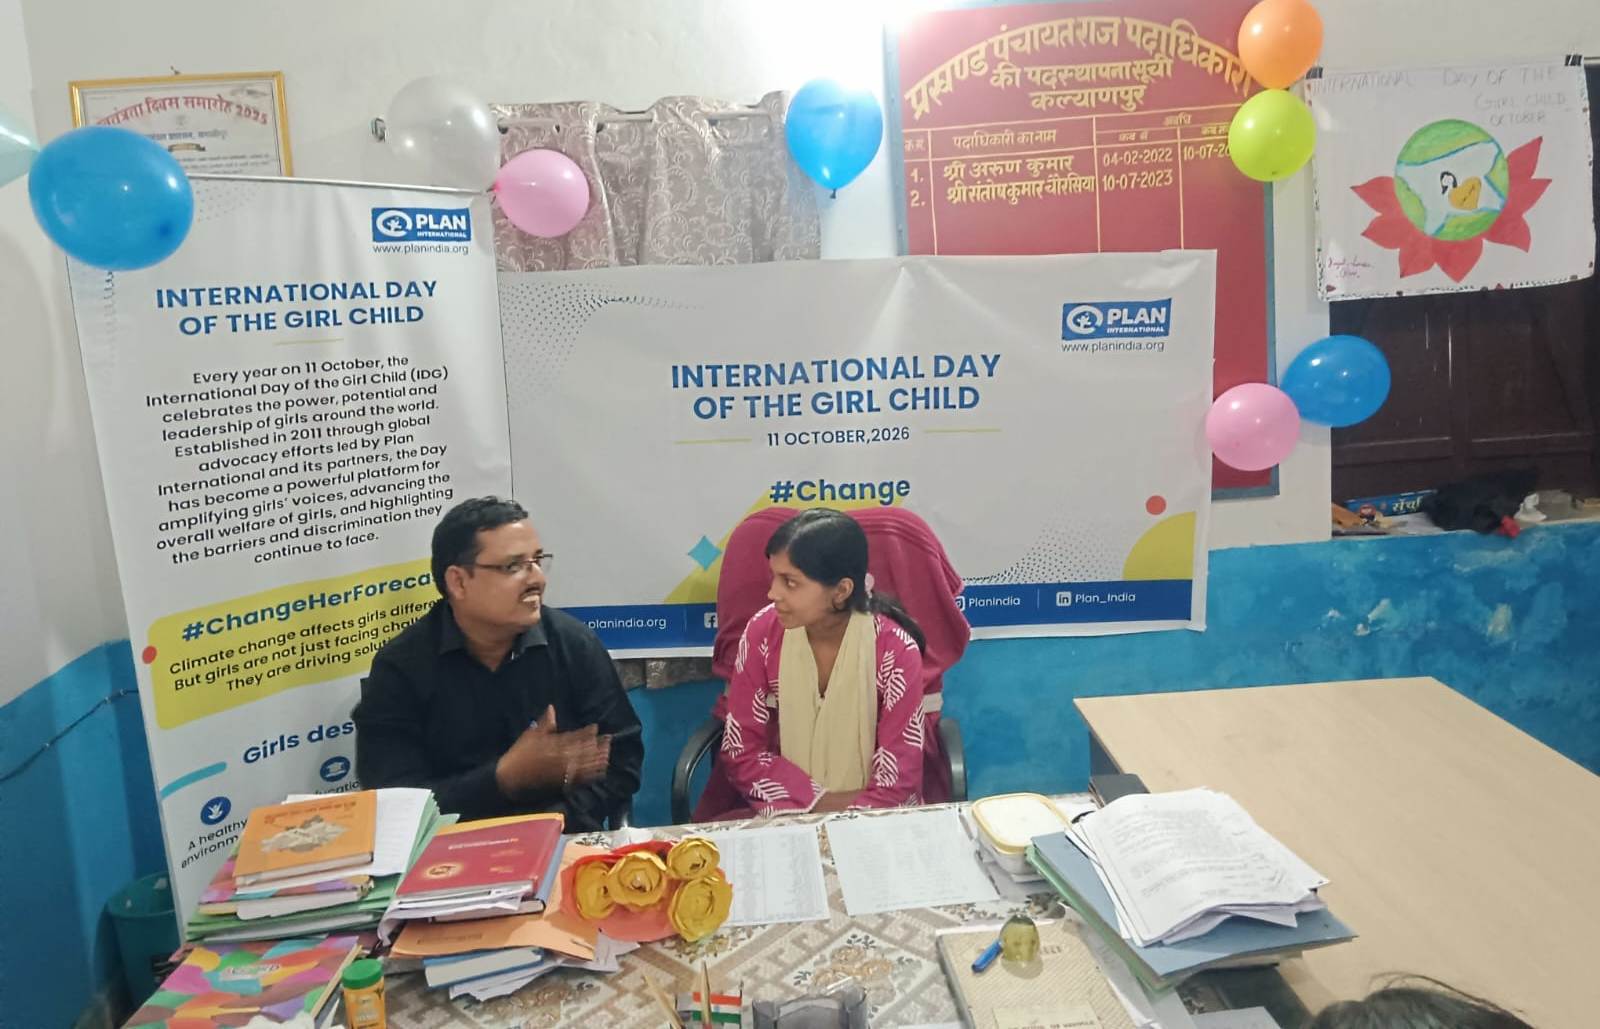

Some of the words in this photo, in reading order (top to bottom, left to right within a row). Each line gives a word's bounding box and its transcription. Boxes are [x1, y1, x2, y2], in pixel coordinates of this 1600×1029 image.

[989, 61, 1022, 89] की
[144, 96, 180, 113] दिवस
[182, 93, 233, 113] समारोह
[1029, 85, 1147, 112] कल्याणपुर
[910, 168, 924, 184] 1.
[944, 159, 966, 181] श्री
[1026, 156, 1074, 178] कुमार
[1103, 147, 1173, 167] 04-02-2022
[1183, 143, 1230, 161] 10-07-20
[910, 191, 926, 207] 2.
[1102, 169, 1173, 192] 10-07-2023
[415, 213, 467, 230] PLAN
[372, 244, 469, 255] www.planindia.org
[156, 283, 381, 309] INTERNATIONAL
[386, 280, 438, 299] DAY
[179, 317, 217, 337] OF
[226, 313, 278, 333] THE
[285, 308, 342, 330] GIRL
[348, 306, 424, 326] CHILD
[1107, 307, 1166, 325] PLAN
[1061, 341, 1165, 353] www.planindia.org
[146, 384, 257, 407] International
[261, 381, 290, 396] Day
[294, 378, 310, 391] of
[314, 377, 339, 390] the
[342, 373, 367, 388] Girl
[370, 370, 407, 385] Child
[410, 365, 449, 383] (IDG)
[193, 369, 238, 385] Every
[243, 366, 277, 383] year
[281, 364, 301, 376] on
[305, 361, 317, 374] 11
[321, 357, 385, 373] October,
[387, 355, 409, 367] the
[671, 355, 925, 389] INTERNATIONAL
[933, 353, 1001, 380] DAY
[162, 403, 253, 424] celebrates
[257, 399, 281, 413] the
[285, 394, 339, 412] power,
[342, 386, 406, 406] potential
[409, 383, 437, 397] and
[162, 419, 252, 442] leadership
[256, 416, 271, 430] of
[274, 411, 308, 430] girls
[312, 405, 366, 423] around
[370, 403, 394, 417] the
[397, 399, 440, 413] world.
[693, 395, 734, 420] OF
[744, 392, 803, 418] THE
[811, 389, 881, 415] GIRL
[888, 386, 981, 411] CHILD
[174, 435, 269, 458] Established
[273, 431, 287, 444] in
[290, 427, 321, 442] 2011
[326, 421, 384, 439] through
[388, 414, 430, 432] global
[199, 451, 278, 472] advocacy
[281, 443, 334, 459] efforts
[337, 439, 358, 452] led
[361, 436, 380, 450] by
[384, 432, 414, 446] Plan
[768, 433, 780, 447] 11
[784, 426, 910, 447] OCTOBER,2026
[158, 469, 265, 496] International
[269, 463, 299, 478] and
[303, 459, 324, 473] its
[327, 452, 393, 474] partners,
[397, 447, 418, 460] the
[420, 444, 447, 459] Day
[168, 496, 200, 512] has
[204, 485, 269, 506] become
[273, 483, 283, 493] a
[287, 472, 355, 494] powerful
[358, 463, 420, 483] platform
[422, 459, 440, 472] for
[158, 506, 249, 532] amplifying
[292, 490, 348, 507] voices,
[350, 477, 425, 499] advancing
[428, 472, 451, 486] the
[770, 478, 912, 506] #Change
[156, 529, 214, 550] overall
[218, 518, 275, 538] welfare
[279, 512, 293, 526] of
[297, 507, 337, 525] girls,
[340, 502, 367, 516] and
[370, 486, 454, 511] highlighting
[172, 550, 200, 565] the
[204, 537, 265, 559] barriers
[269, 528, 300, 544] and
[303, 511, 411, 538] discrimination
[414, 503, 442, 519] they
[254, 541, 322, 564] continue
[327, 538, 342, 550] to
[345, 530, 379, 547] face.
[182, 571, 431, 642] #ChangeHerForeca
[586, 618, 667, 630] planindia.org
[1075, 591, 1136, 604] Plan_India
[169, 649, 235, 675] Climate
[238, 630, 296, 655] change
[299, 618, 355, 638] affects
[358, 609, 387, 628] girls
[174, 674, 201, 691] But
[205, 663, 239, 685] girls
[243, 656, 268, 671] are
[271, 647, 297, 662] not
[300, 639, 331, 657] just
[334, 627, 379, 649] facing
[226, 671, 264, 692] They
[267, 663, 291, 679] are
[295, 652, 351, 671] driving
[243, 733, 300, 764] Girls
[307, 721, 354, 743] des
[181, 834, 239, 869] environm
[188, 840, 196, 851] A
[199, 817, 248, 845] healthy
